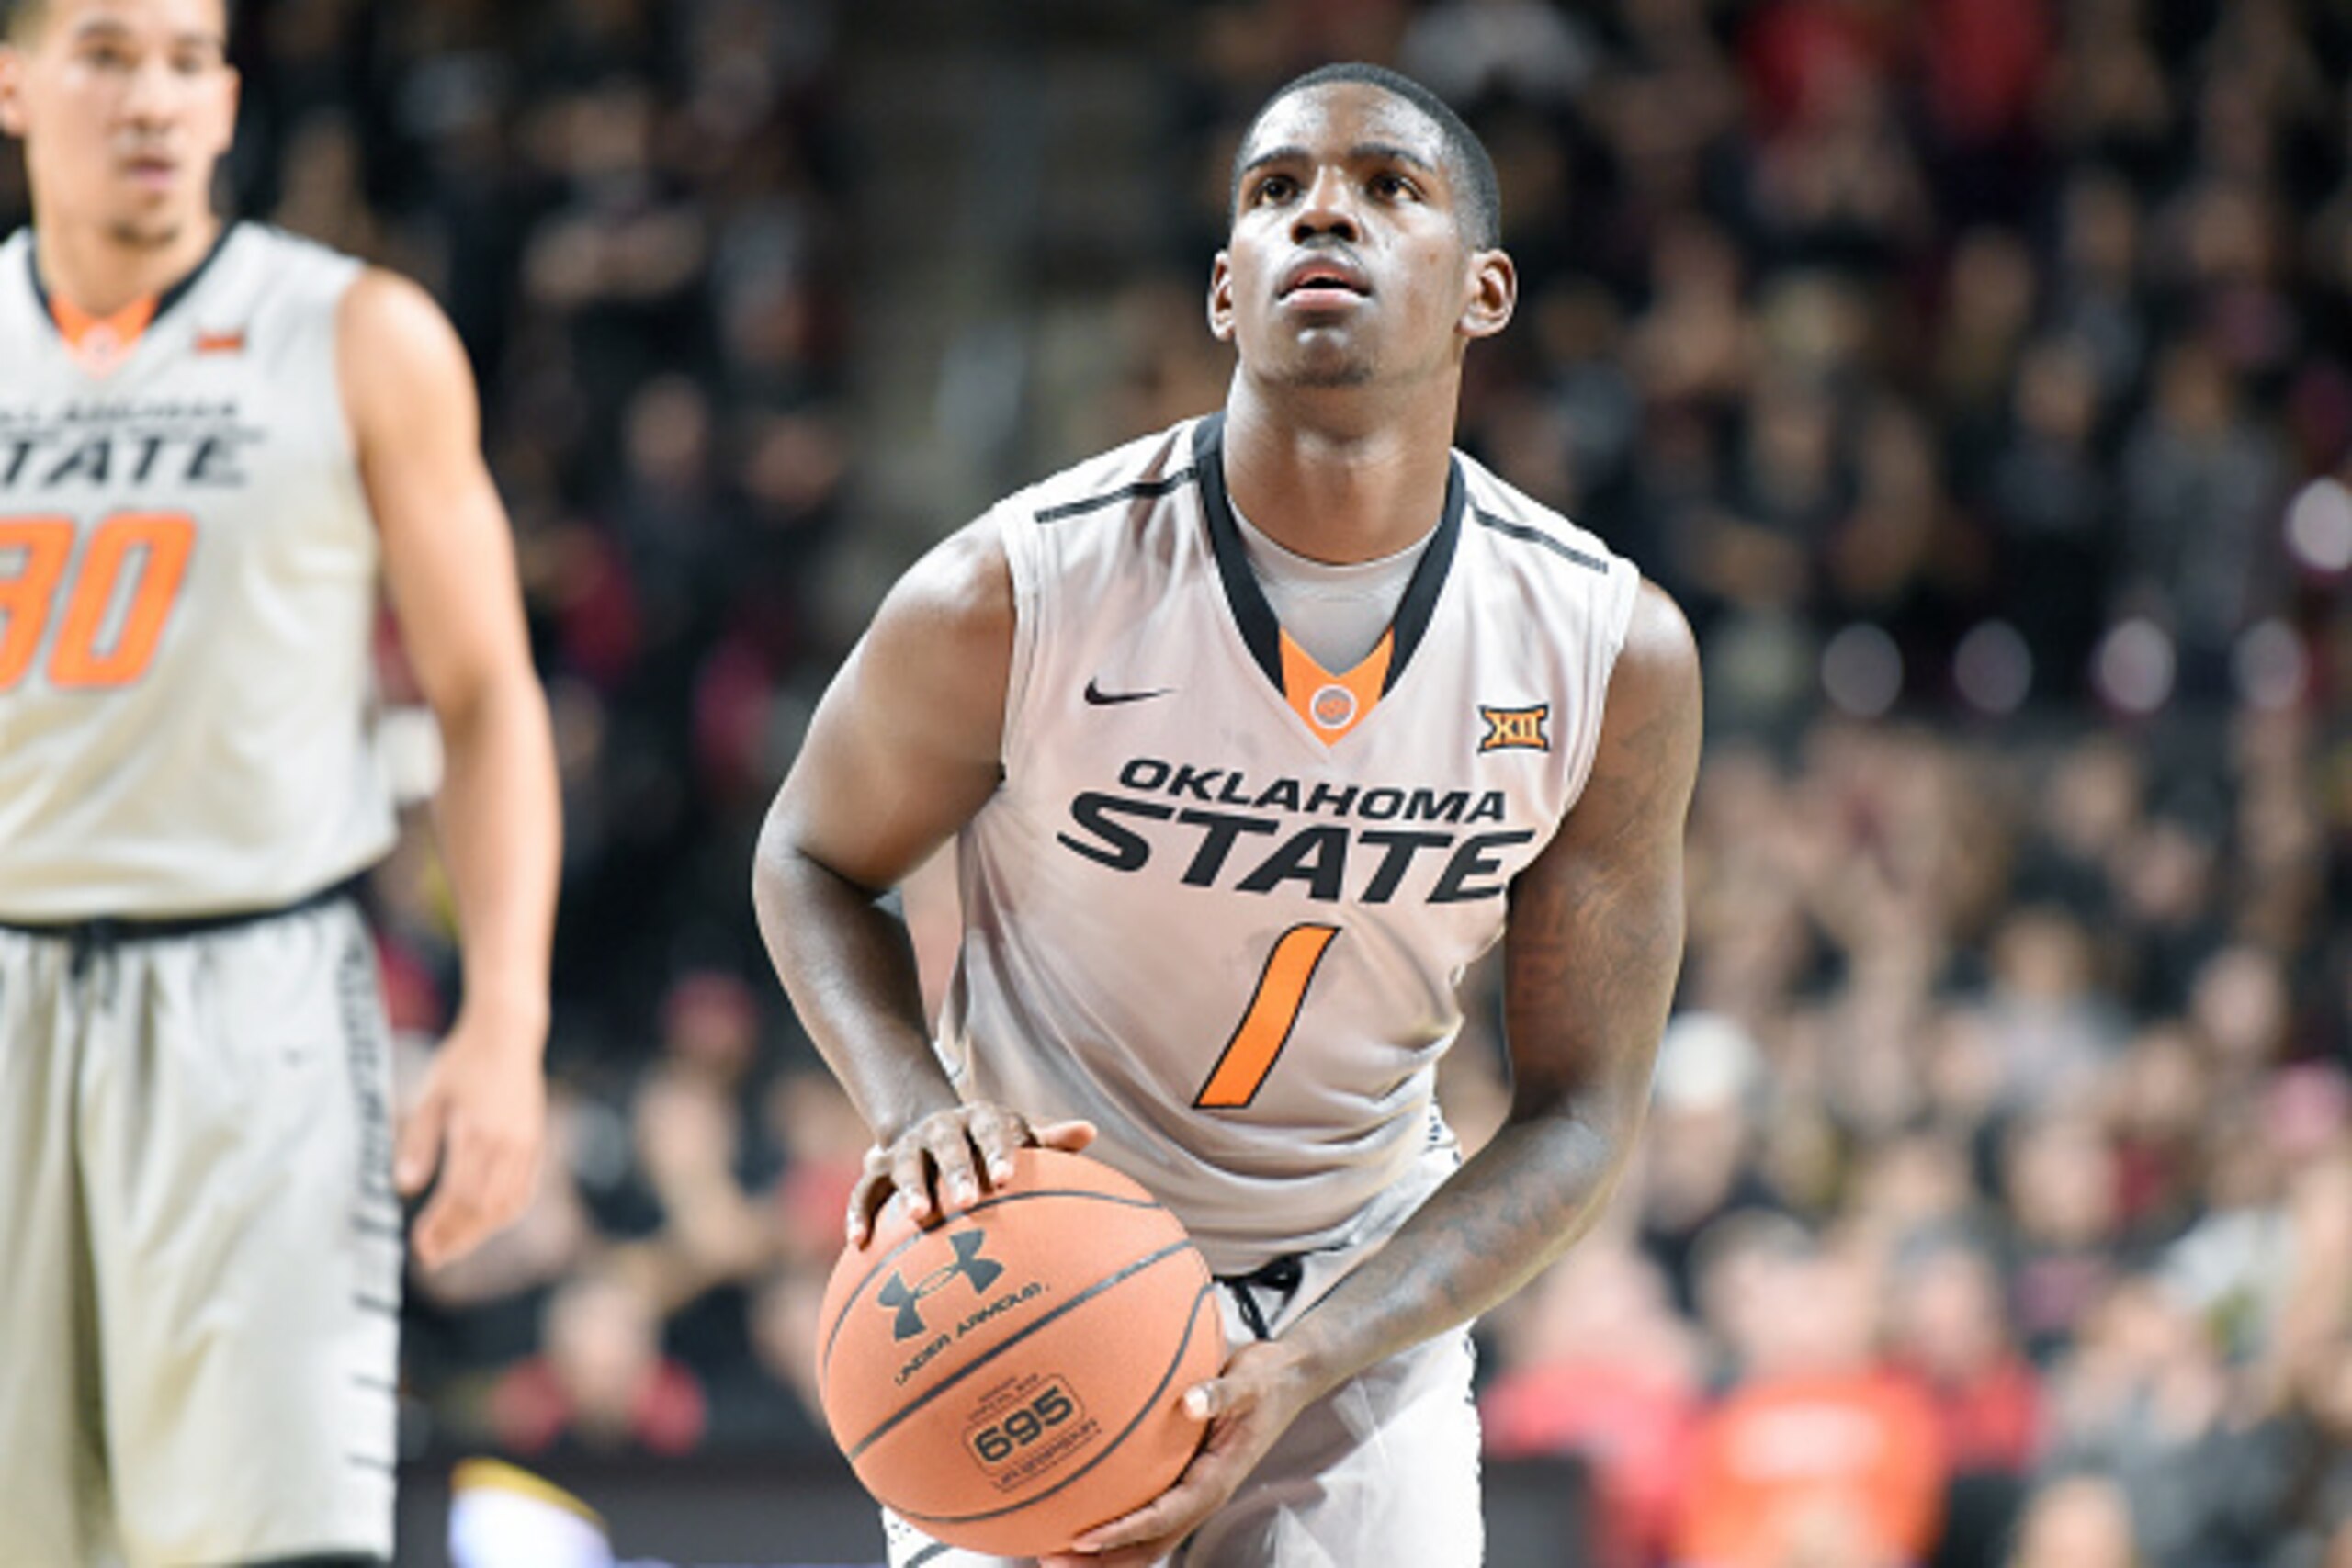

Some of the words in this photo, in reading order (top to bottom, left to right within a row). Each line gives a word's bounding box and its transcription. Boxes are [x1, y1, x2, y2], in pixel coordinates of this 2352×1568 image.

[0, 427, 265, 487] TATE
[1118, 758, 1507, 823] OKLAHOMA
[1056, 790, 1537, 904] STATE
[1191, 921, 1342, 1109] 1
[894, 1333, 951, 1386] UNDER
[956, 1282, 1042, 1338] ARMOUR
[974, 1385, 1073, 1462] 695
